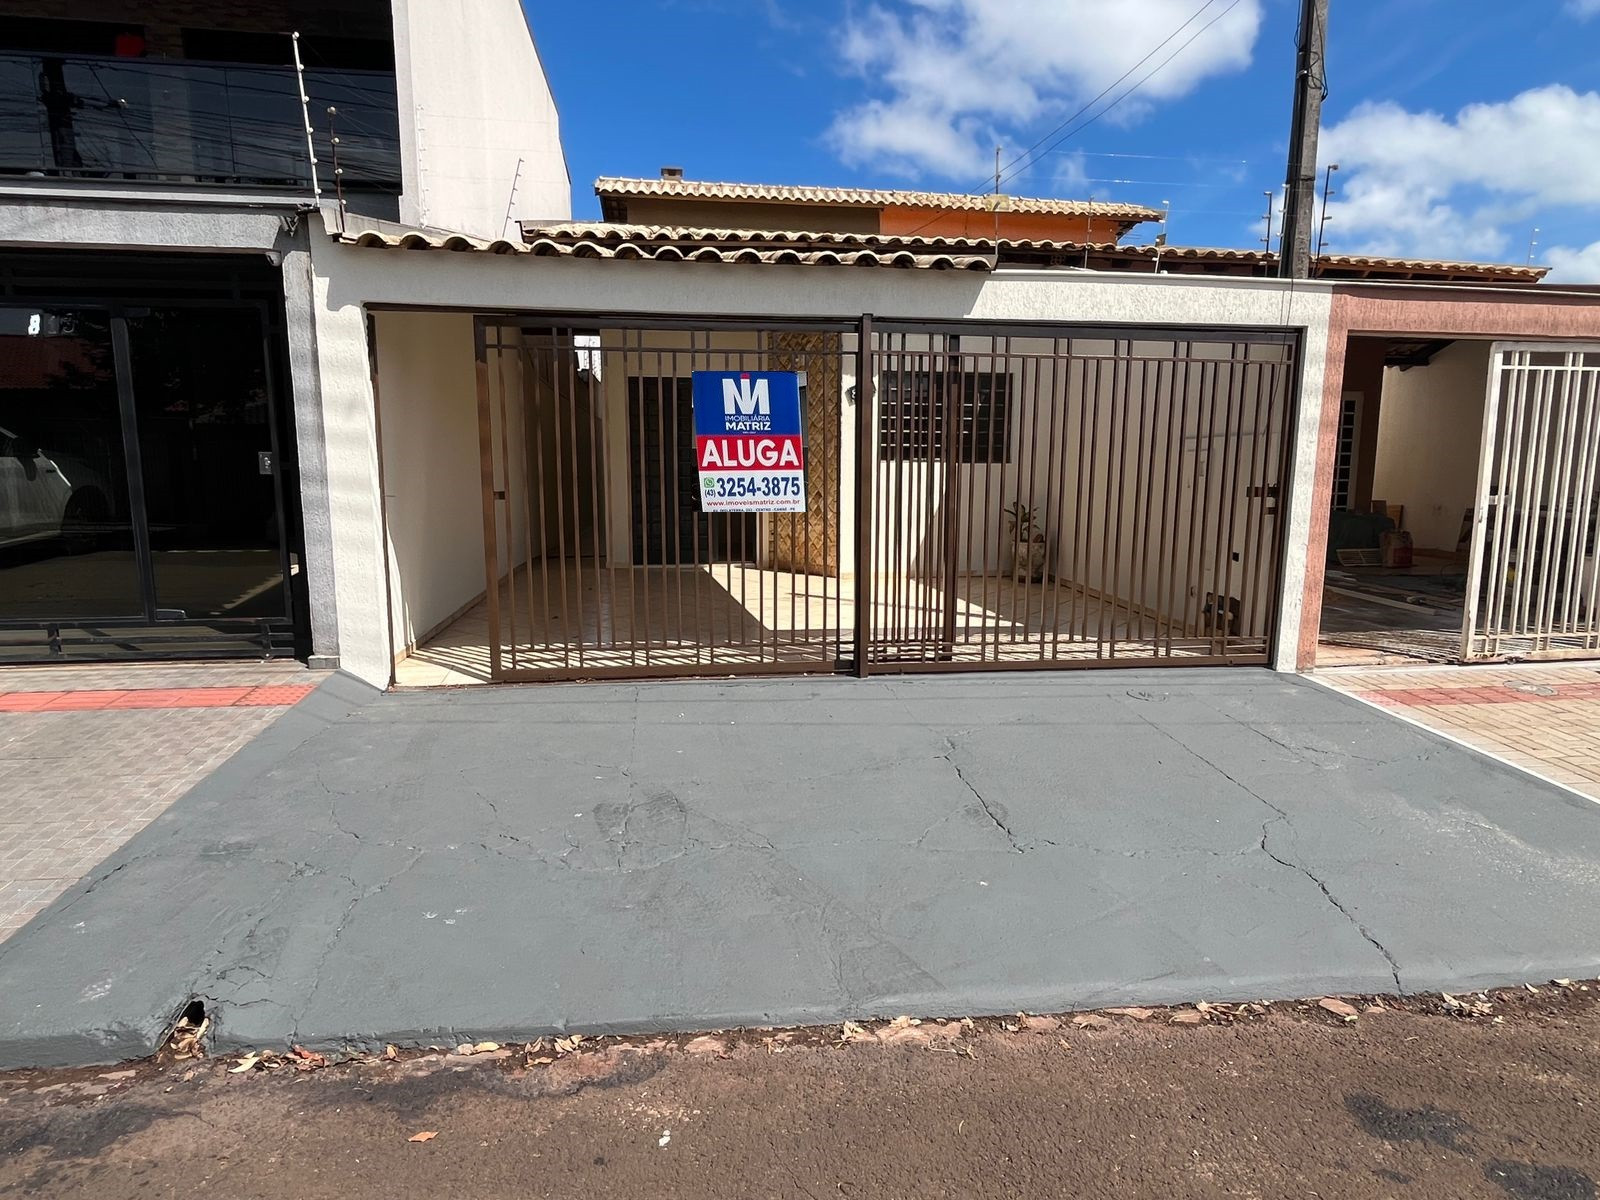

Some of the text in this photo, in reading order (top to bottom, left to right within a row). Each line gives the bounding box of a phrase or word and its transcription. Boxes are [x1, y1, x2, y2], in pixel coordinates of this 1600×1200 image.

[725, 421, 771, 431] MATRIZ
[701, 439, 800, 467] ALUGA
[704, 477, 800, 498] (43) 3254-3875
